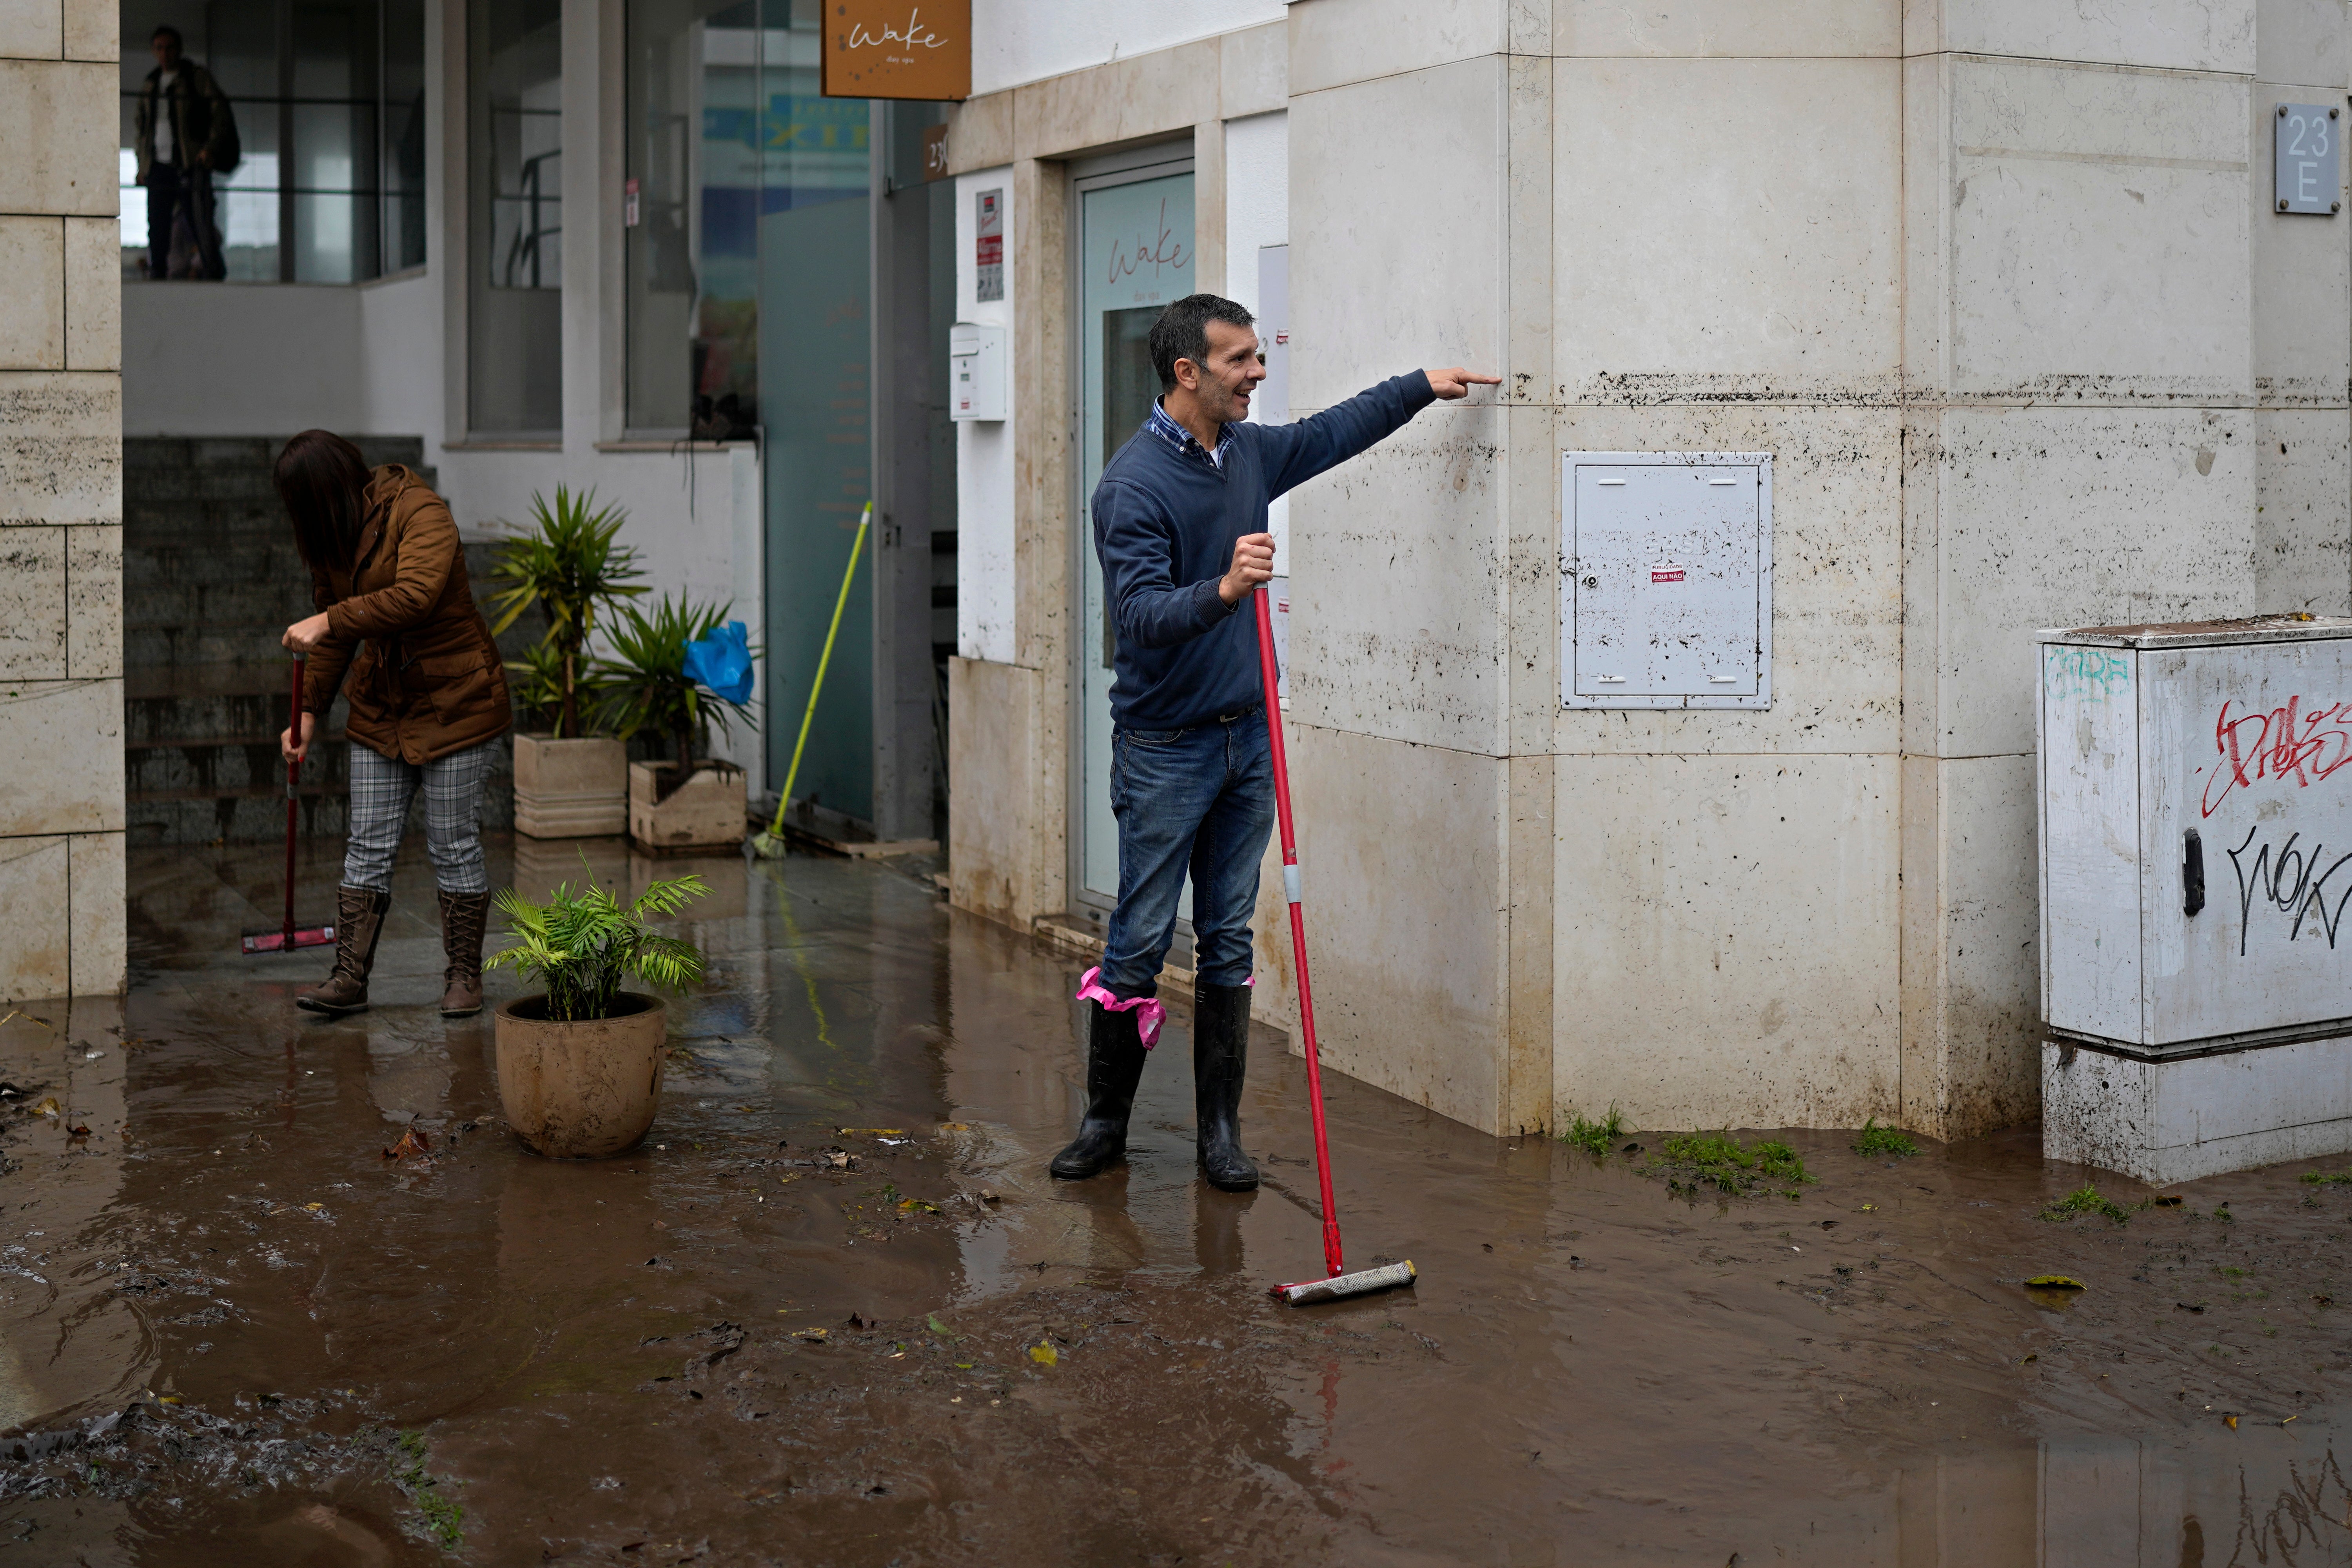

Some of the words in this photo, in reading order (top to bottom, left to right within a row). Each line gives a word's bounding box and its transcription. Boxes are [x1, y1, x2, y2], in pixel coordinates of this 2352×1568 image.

[2288, 115, 2329, 157] 23
[2299, 161, 2319, 202] E
[1641, 531, 1694, 555] GAS
